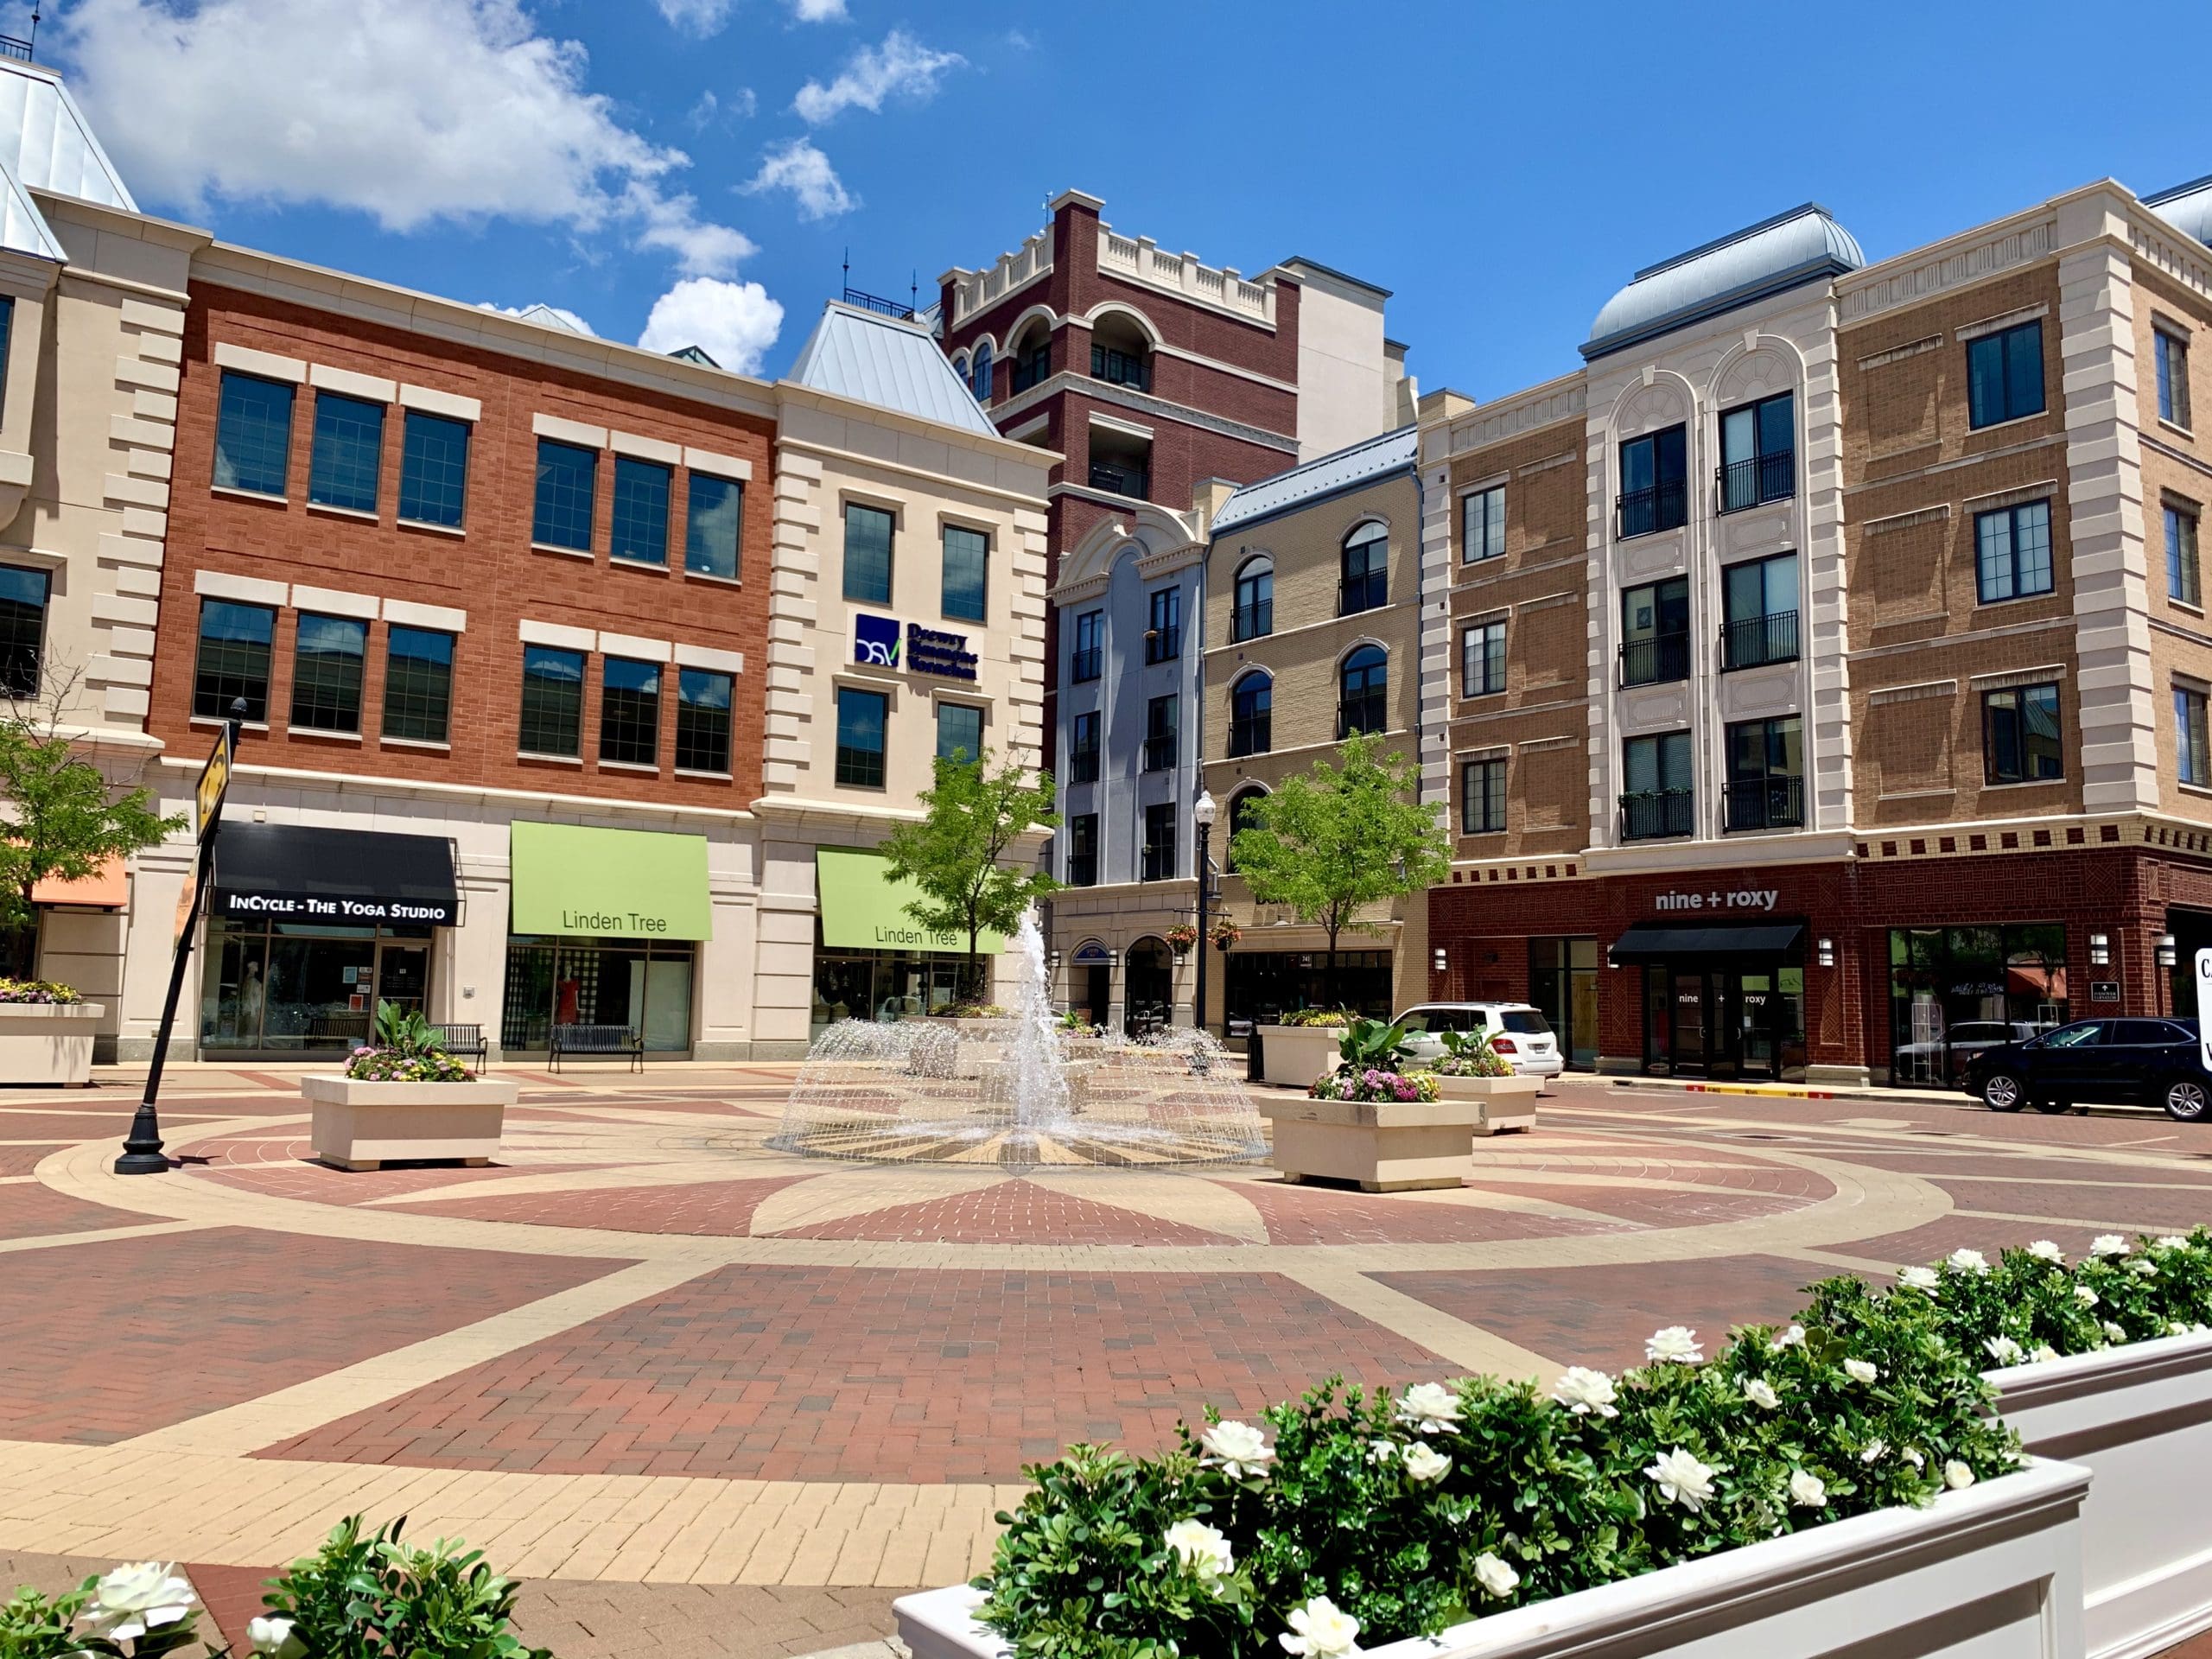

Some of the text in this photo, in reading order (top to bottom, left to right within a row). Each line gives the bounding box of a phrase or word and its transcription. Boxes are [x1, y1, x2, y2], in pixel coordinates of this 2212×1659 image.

[307, 899, 336, 913] THE
[341, 900, 385, 917] YOGA
[391, 904, 445, 919] STUDIO
[1656, 890, 1703, 910] nine
[1727, 890, 1779, 911] roxy
[563, 910, 667, 931] Linden Tree
[875, 926, 957, 946] Linden Tree
[1679, 994, 1699, 1003] nine
[1745, 995, 1766, 1006] roxy
